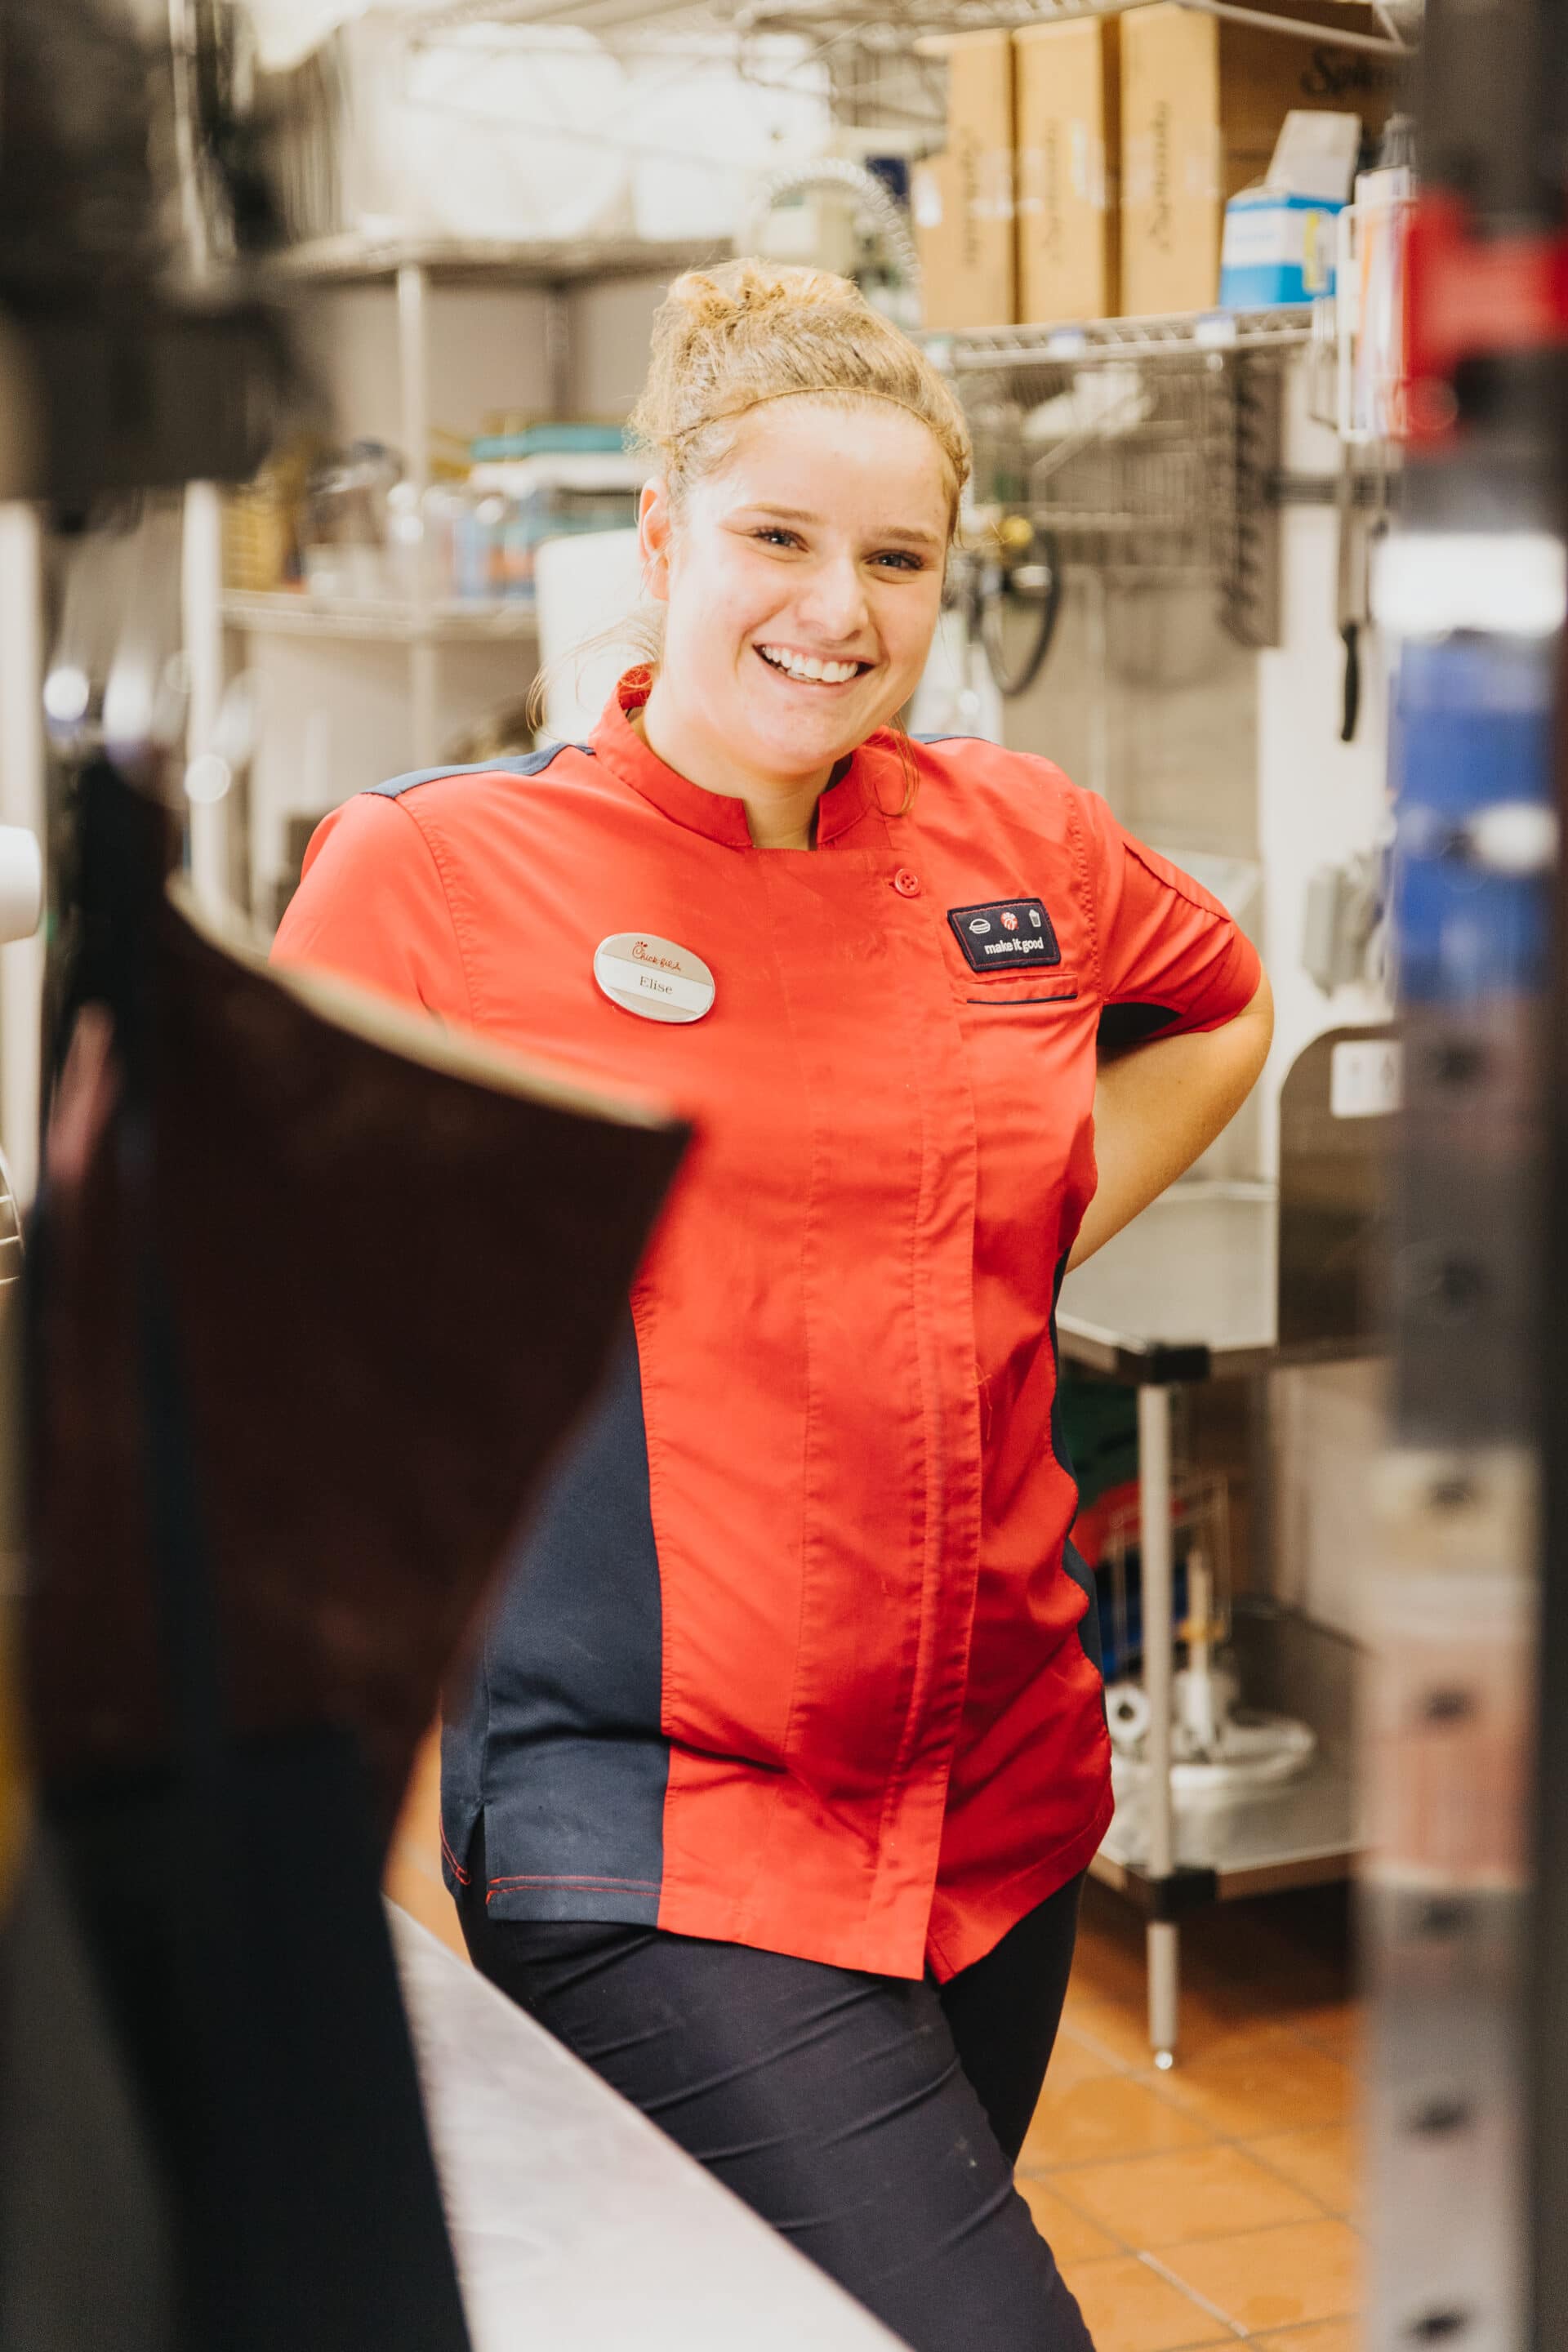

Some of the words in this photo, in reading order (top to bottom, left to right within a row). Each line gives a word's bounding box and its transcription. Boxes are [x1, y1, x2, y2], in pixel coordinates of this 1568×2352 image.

[984, 939, 1013, 955] make
[1012, 938, 1022, 951] it
[1022, 936, 1045, 954] good
[639, 976, 673, 995] Elise
